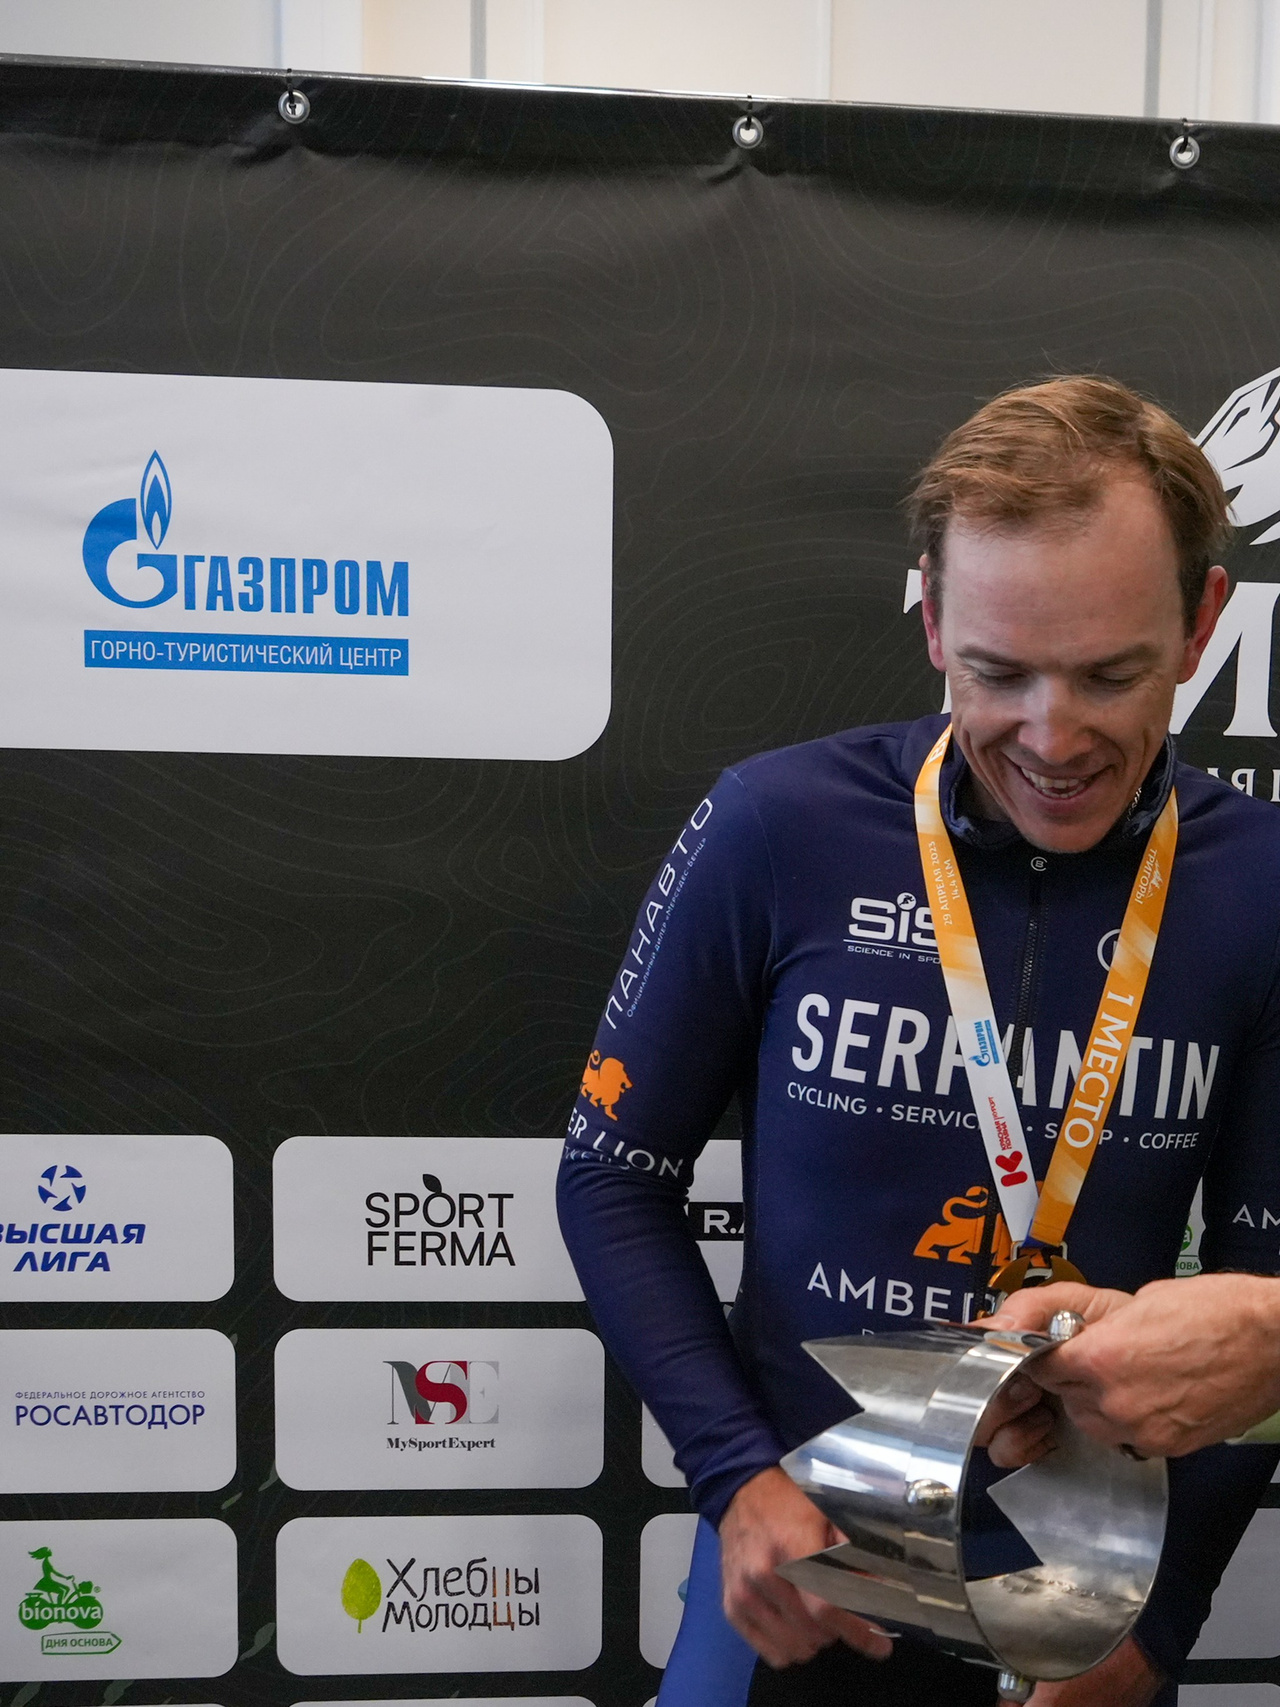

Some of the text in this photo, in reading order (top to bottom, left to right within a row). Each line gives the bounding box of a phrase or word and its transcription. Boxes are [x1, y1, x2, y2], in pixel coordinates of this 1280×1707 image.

[184, 555, 409, 617] ГАЗПРОМ
[91, 640, 402, 670] ГОРНО-ТУРИСТИЧЕСКИЙ ЦЕНТР
[933, 868, 950, 912] АПРЕЛЯ
[1135, 848, 1158, 905] ТРИГОРЫ
[604, 797, 714, 1030] ПАНАВТО
[847, 945, 894, 958] SCIENCE
[898, 952, 911, 960] IN
[1064, 990, 1134, 1148] 1 МЕСТО
[787, 1081, 1200, 1150] CYCLING SERVIC SP COFFEE
[593, 1131, 683, 1178] LION
[365, 1191, 515, 1228] SPORT
[13, 1251, 112, 1272] ЛИГА
[366, 1231, 517, 1267] FERMA
[15, 1390, 206, 1400] ФЕДЕРАЛЬНОЕ ДОРОЖНОЕ АГЕНТСТВО
[15, 1404, 206, 1430] РОСАВТОДОР
[386, 1437, 496, 1452] MySportExpert
[20, 1602, 103, 1624] bionova
[45, 1635, 114, 1650] ДНЯ ОСНОВА
